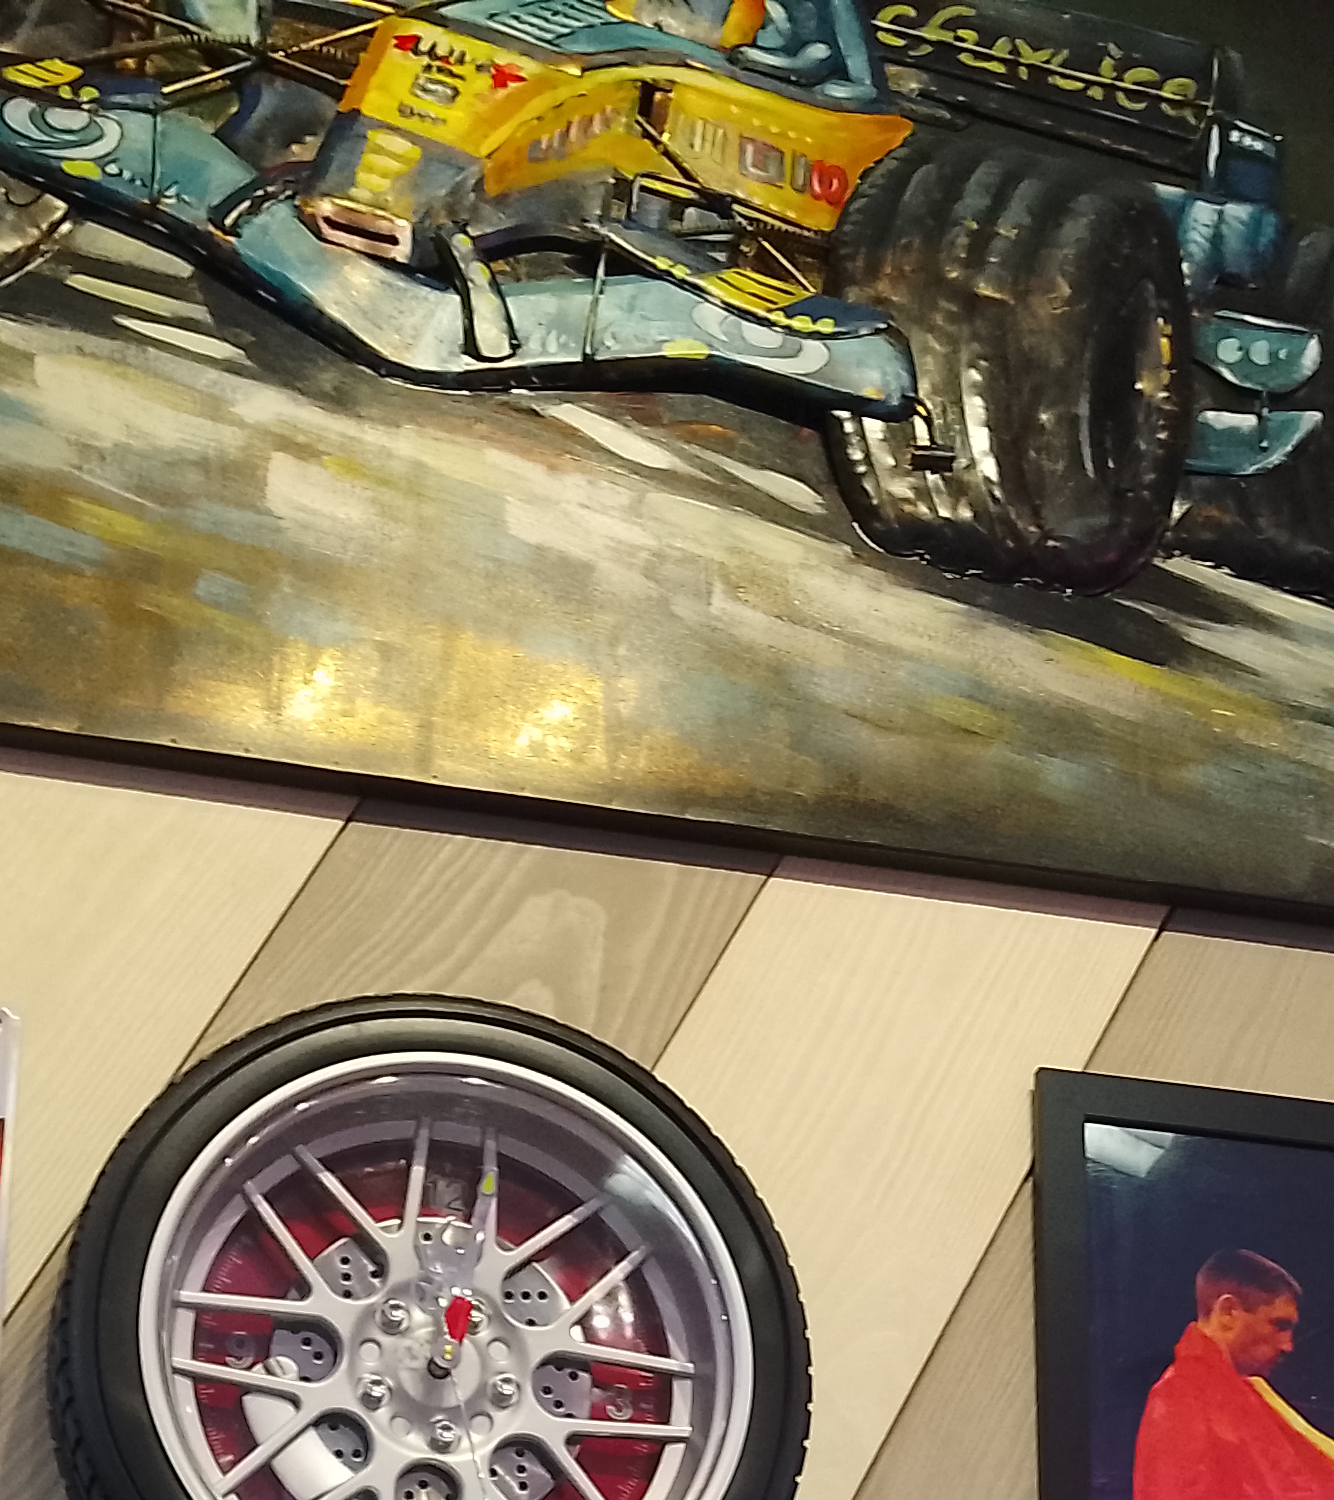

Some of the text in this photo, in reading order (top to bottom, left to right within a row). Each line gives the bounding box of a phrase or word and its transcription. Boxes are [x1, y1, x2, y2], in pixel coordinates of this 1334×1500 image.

[426, 1178, 465, 1212] 12
[225, 1331, 255, 1369] 9
[605, 1383, 634, 1420] 3
